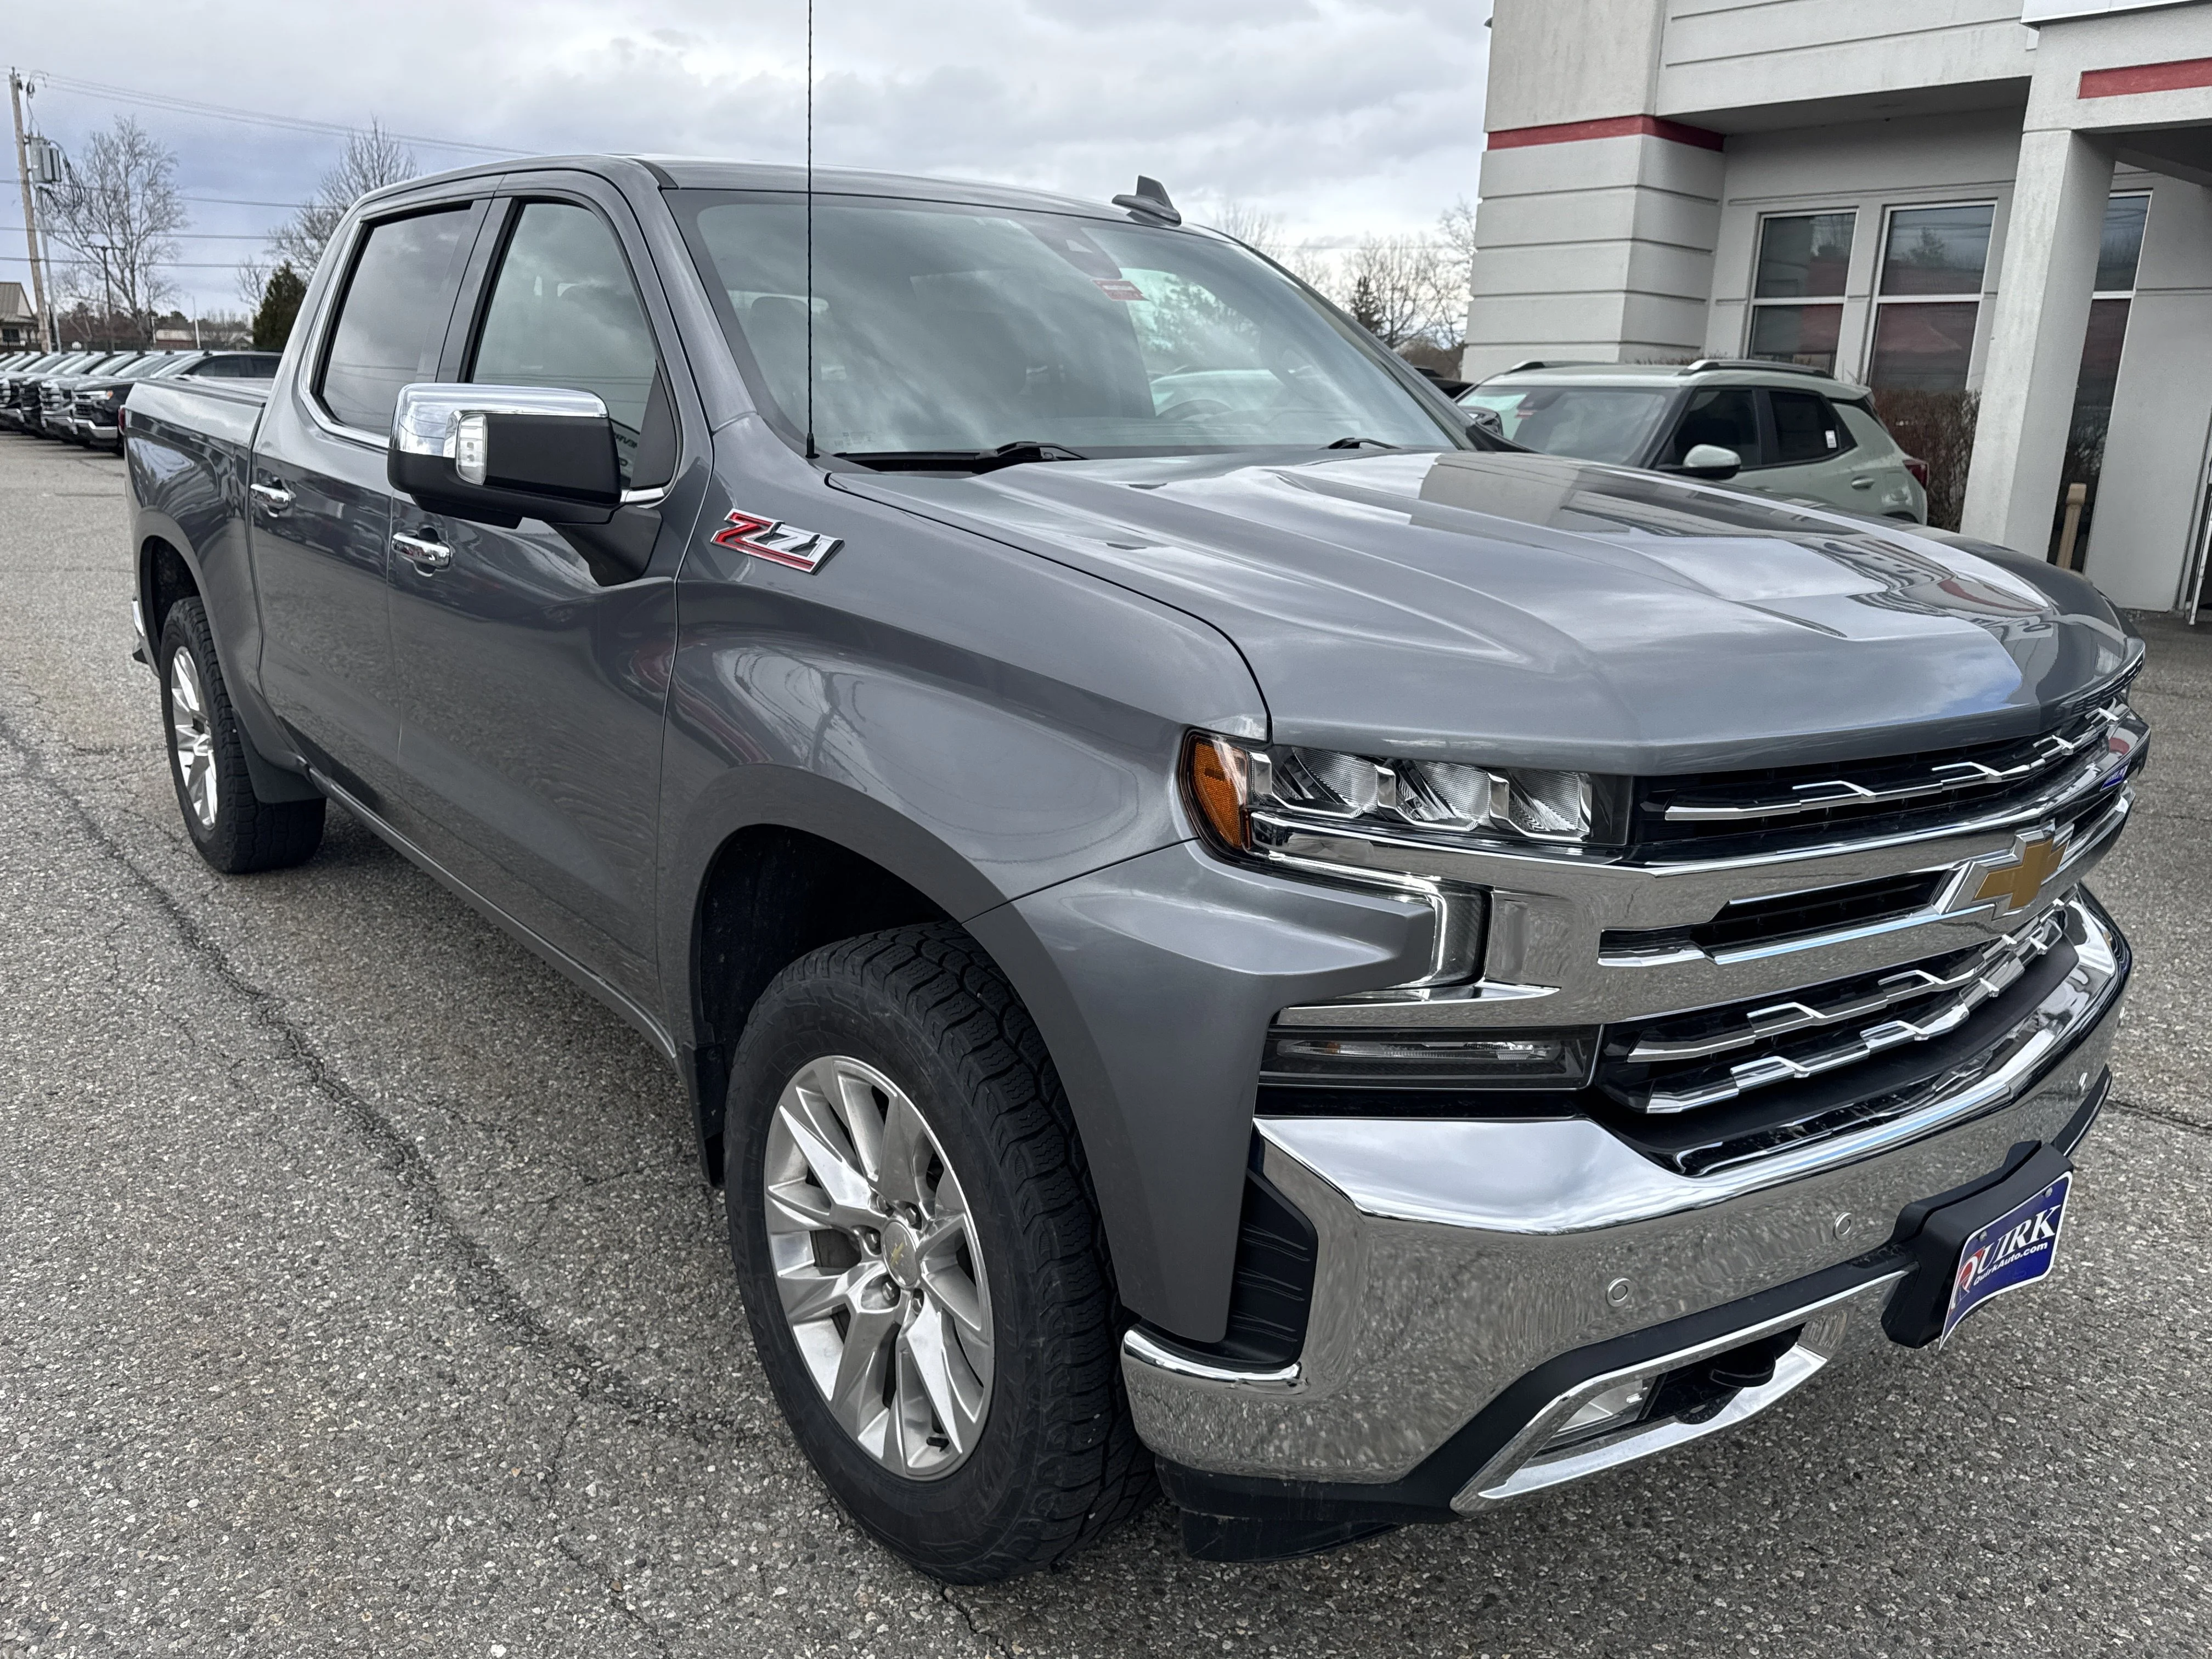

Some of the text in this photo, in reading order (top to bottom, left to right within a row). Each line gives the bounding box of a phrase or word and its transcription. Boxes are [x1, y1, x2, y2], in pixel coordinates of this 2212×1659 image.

[710, 508, 845, 575] Z71
[1951, 1205, 2061, 1309] QUIRK
[1973, 1242, 2048, 1286] QuirkAuto.com
